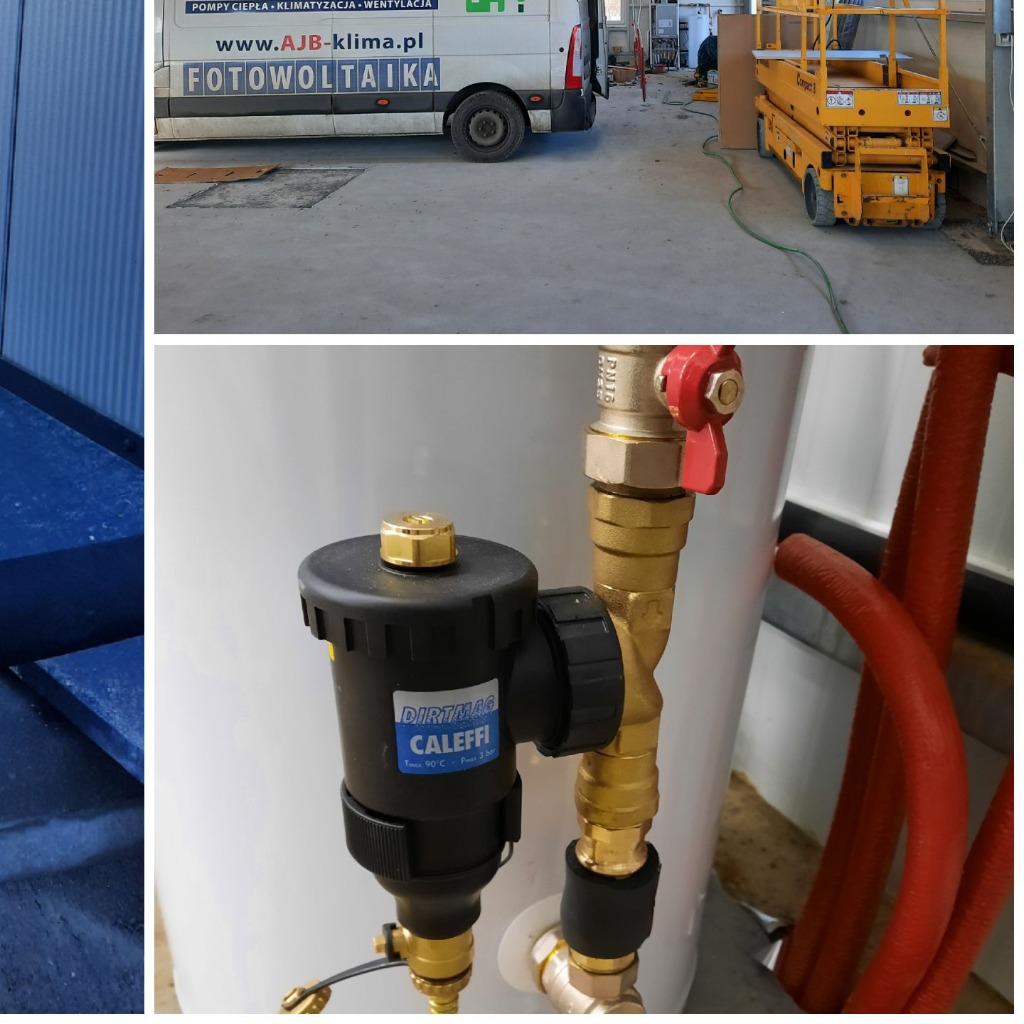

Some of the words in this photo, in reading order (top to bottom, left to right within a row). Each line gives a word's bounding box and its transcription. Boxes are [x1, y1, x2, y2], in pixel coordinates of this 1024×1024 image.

[192, 3, 230, 12] POMPY
[231, 2, 269, 11] CIEPŁA
[277, 1, 356, 10] KLIMATYZACJA
[363, 0, 432, 9] WENTYLACJA
[215, 32, 424, 53] www.AJB-klima.pl
[188, 62, 439, 92] FOTOWOLTAIKA
[402, 695, 495, 724] DIRTMAG
[410, 725, 489, 755] CALEFFI
[404, 759, 422, 768] Tmax
[425, 759, 446, 768] 90°C
[460, 756, 477, 765] Pmax
